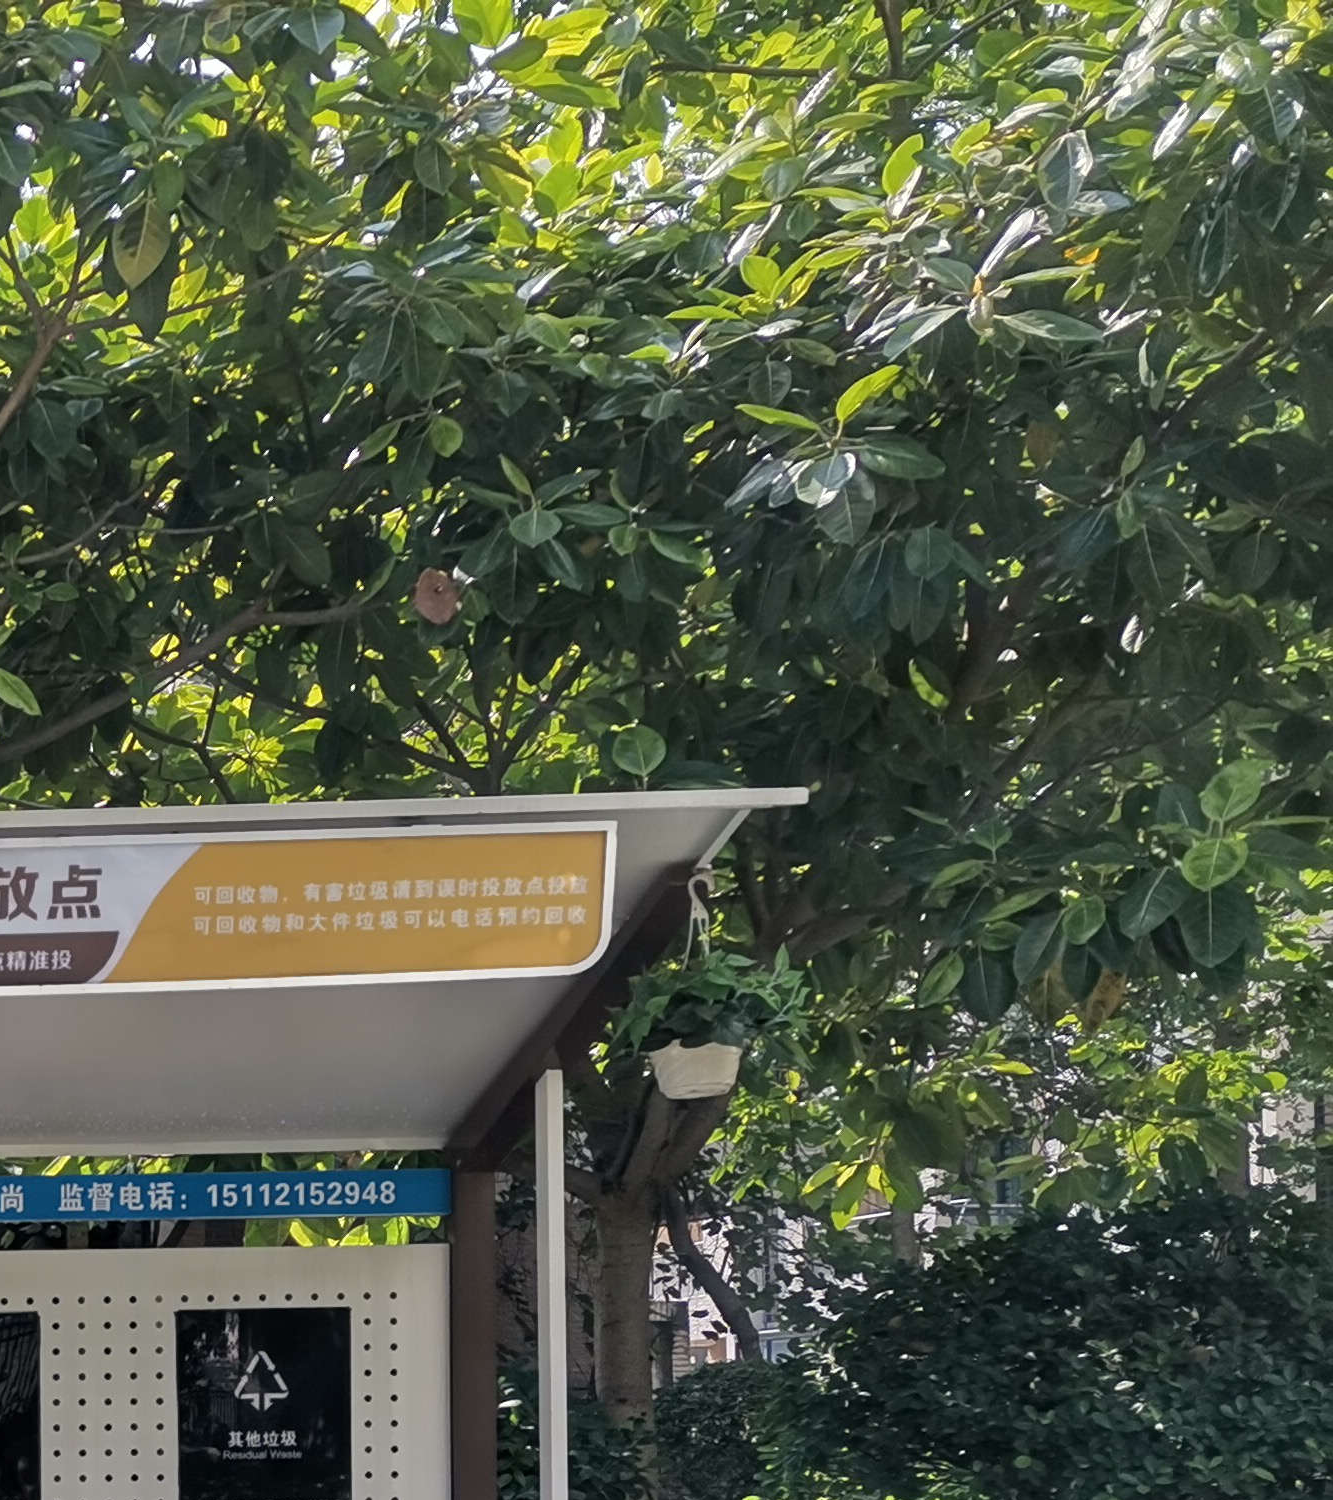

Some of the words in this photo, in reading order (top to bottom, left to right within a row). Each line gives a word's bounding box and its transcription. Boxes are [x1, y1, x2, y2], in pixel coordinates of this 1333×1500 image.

[193, 905, 588, 936] 可回收物和大件垃圾可以电话预约回收
[228, 1430, 298, 1448] 其他垃圾
[222, 1449, 267, 1460] Residual
[269, 1449, 303, 1460] Waste
